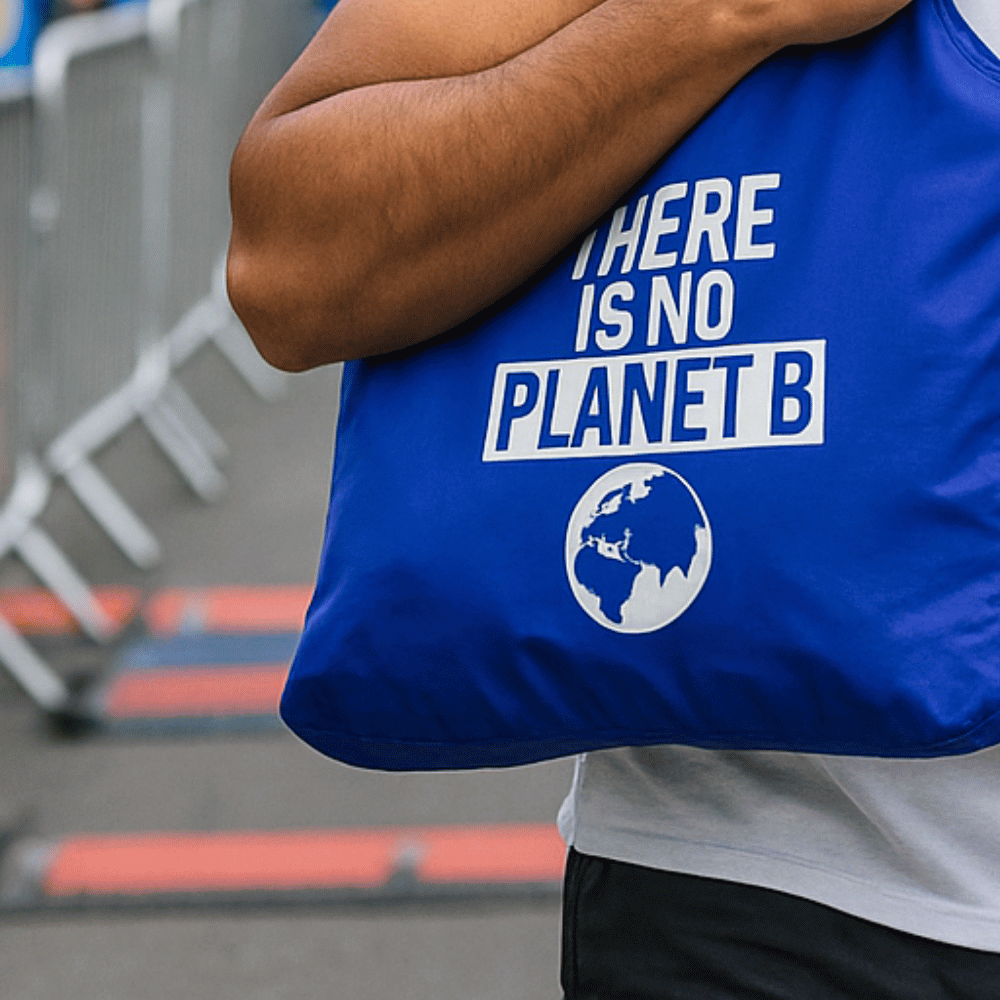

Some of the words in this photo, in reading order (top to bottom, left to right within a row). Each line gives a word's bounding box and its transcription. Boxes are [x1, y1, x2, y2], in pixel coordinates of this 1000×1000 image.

[575, 280, 635, 352] IS
[646, 269, 734, 346] NO
[496, 354, 754, 451] PLANET
[769, 350, 813, 436] B
